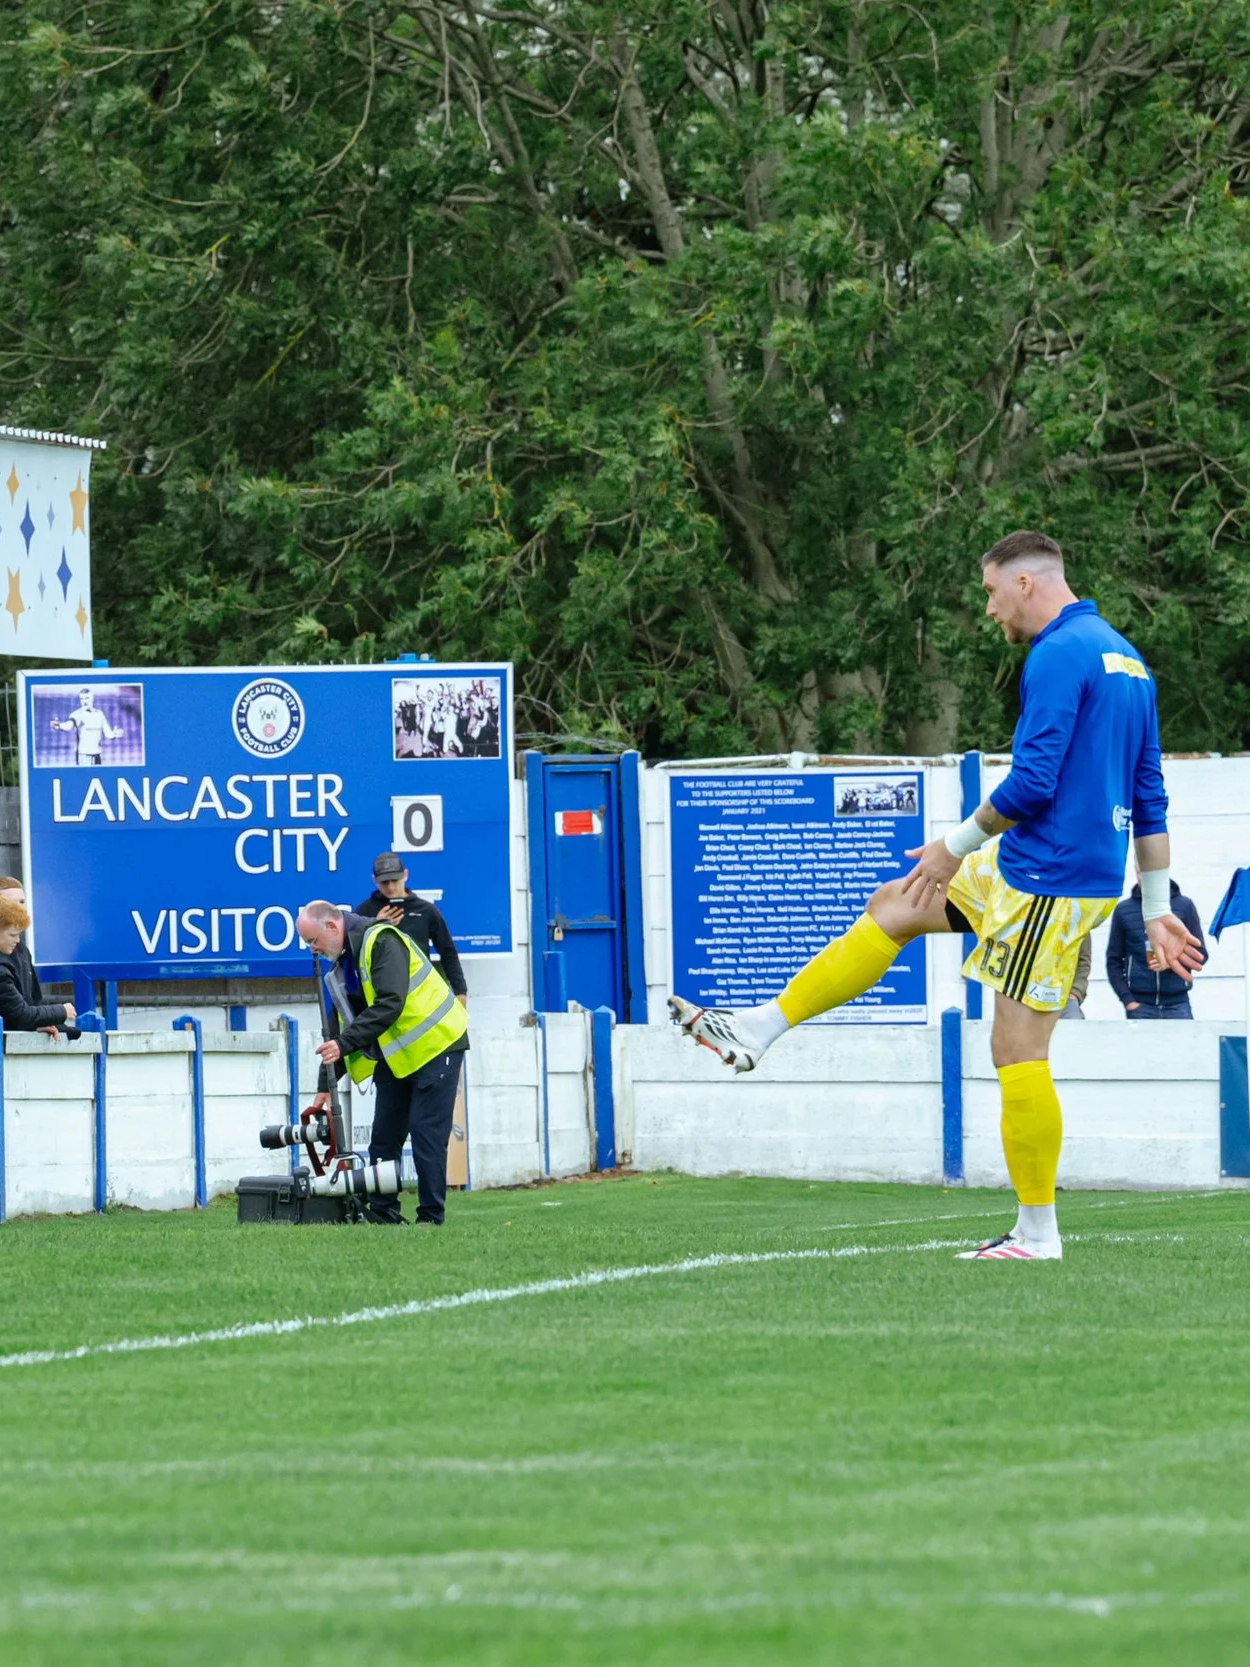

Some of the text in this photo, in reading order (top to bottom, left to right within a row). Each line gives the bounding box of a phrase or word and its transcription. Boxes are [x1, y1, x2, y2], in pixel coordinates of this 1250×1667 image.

[239, 684, 298, 714] LANCASTER CITY
[240, 726, 298, 753] FOOTBALL CLUB
[52, 773, 349, 822] LANCASTER
[404, 802, 433, 847] 0
[234, 827, 349, 874] CITY
[980, 937, 1010, 978] 13
